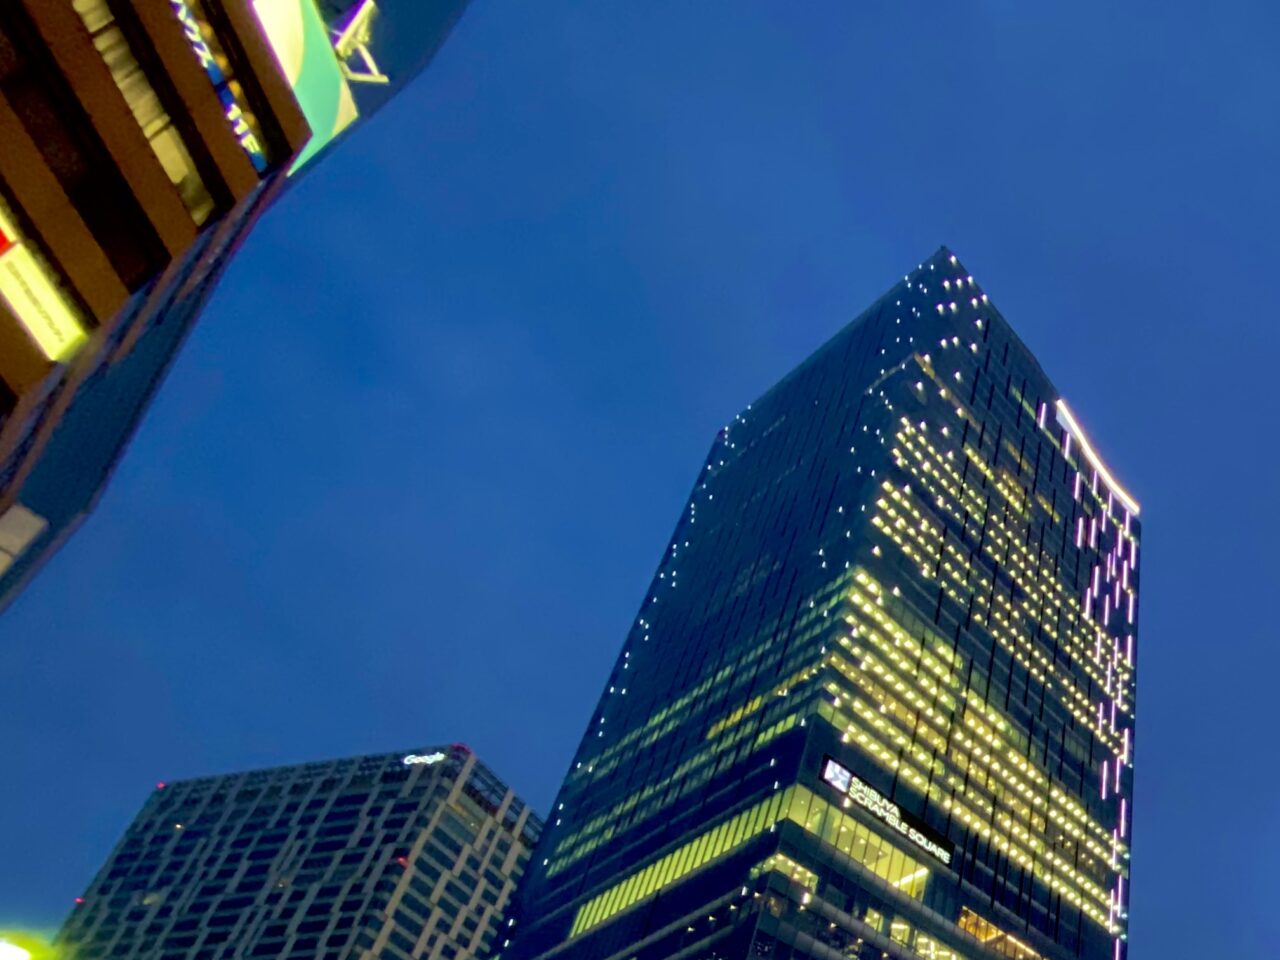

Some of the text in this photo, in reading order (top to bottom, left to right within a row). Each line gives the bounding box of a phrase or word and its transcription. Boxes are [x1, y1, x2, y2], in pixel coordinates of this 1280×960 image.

[848, 786, 952, 865] SCRAMBLE SQUARE
[851, 776, 901, 817] SHIBUYA
